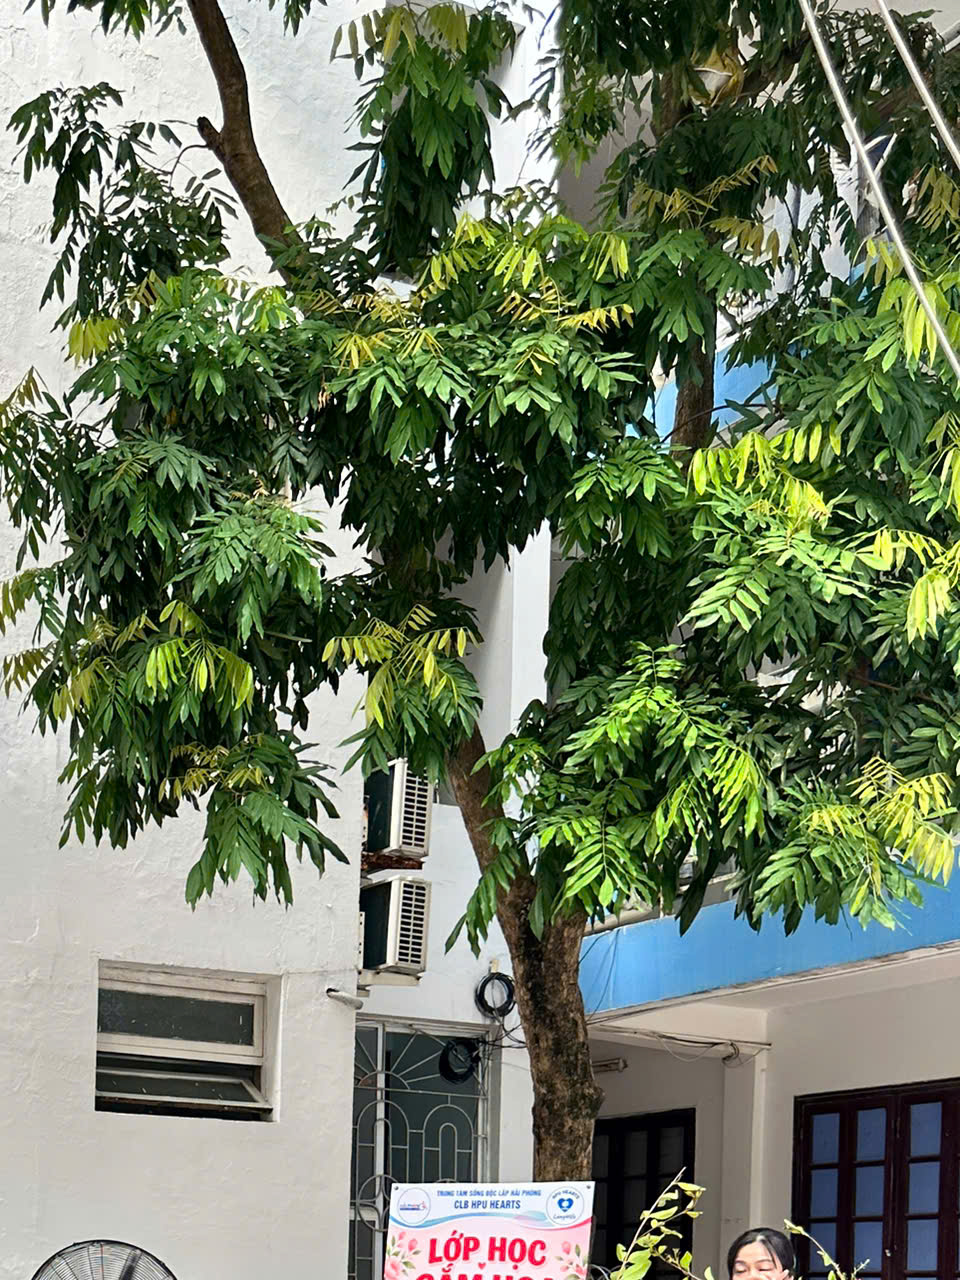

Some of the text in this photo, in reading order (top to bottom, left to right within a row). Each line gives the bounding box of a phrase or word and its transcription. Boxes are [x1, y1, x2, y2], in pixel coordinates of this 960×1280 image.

[454, 1200, 521, 1209] CLB HPU HEARTS
[428, 1230, 546, 1270] LỚP HỌC
